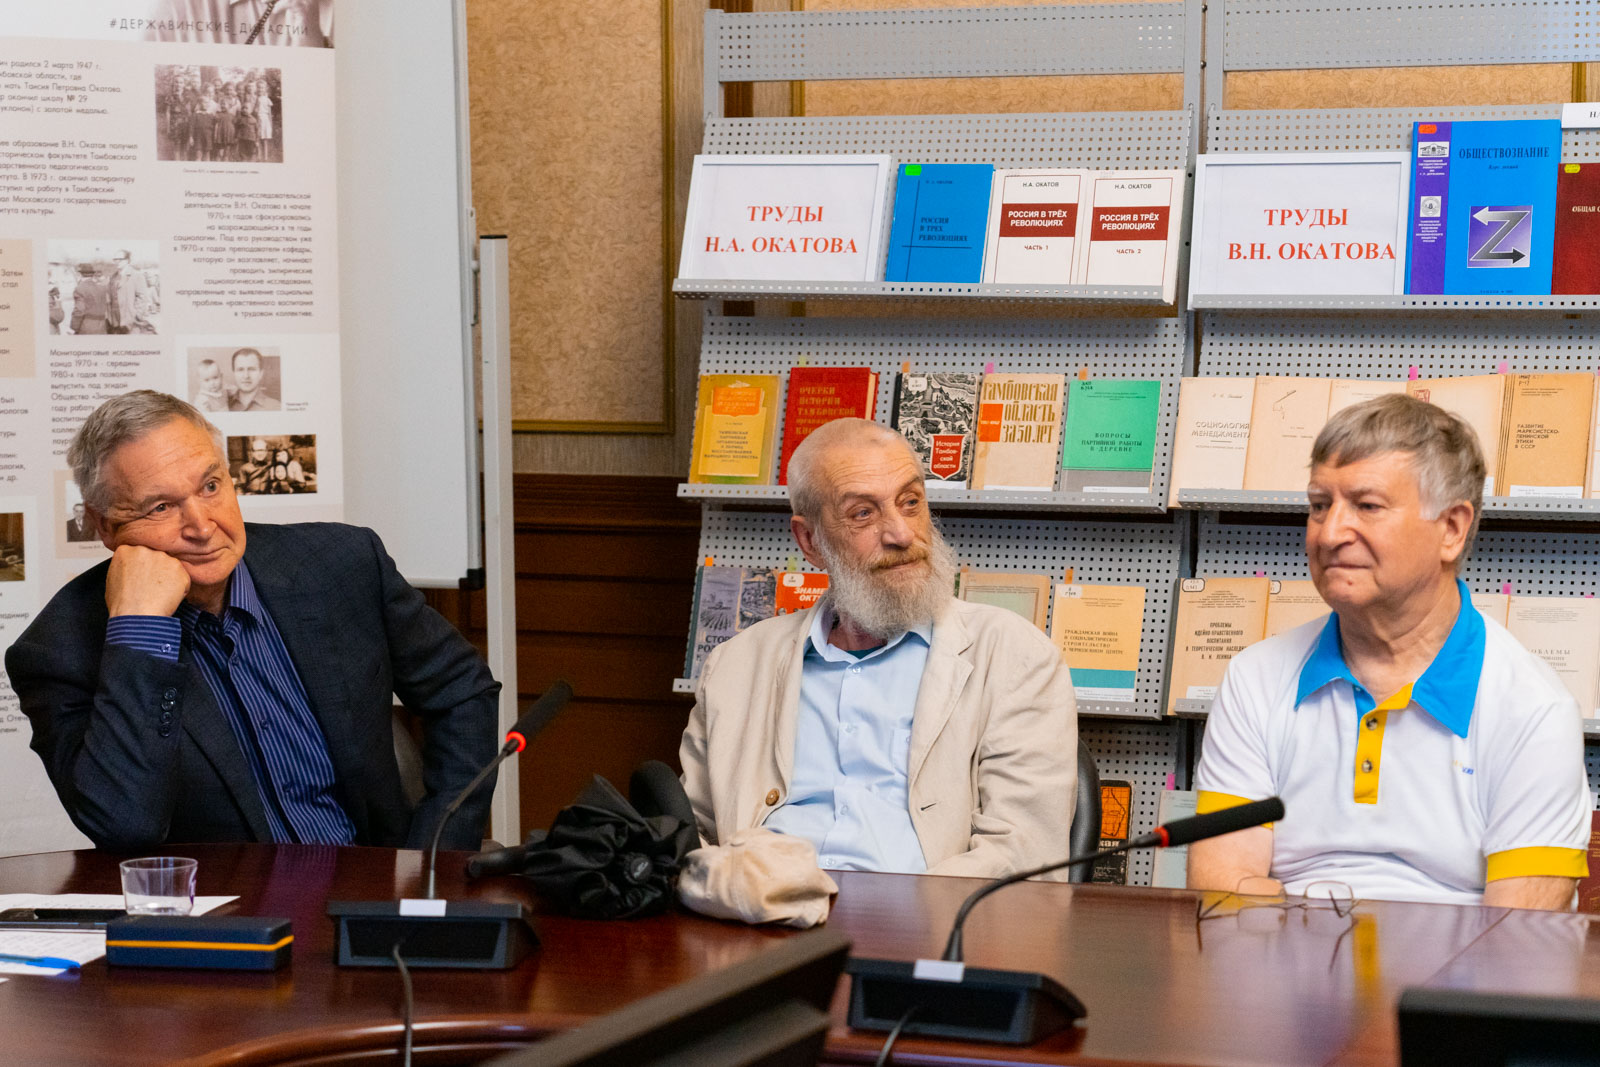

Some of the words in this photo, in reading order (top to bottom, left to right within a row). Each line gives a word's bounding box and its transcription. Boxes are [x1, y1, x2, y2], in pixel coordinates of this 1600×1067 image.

[44, 60, 49, 68] 2
[52, 82, 86, 93] Петровна
[12, 140, 59, 149] образование
[48, 152, 87, 160] факультете
[90, 152, 137, 160] Тамбовского
[1459, 147, 1550, 160] ОБЩЕСТВОЗНАНИЕ
[91, 176, 135, 184] аспирантуру
[37, 184, 62, 194] работу
[748, 206, 824, 224] ТРУДЫ
[1048, 209, 1067, 218] ТРЁХ
[1140, 213, 1159, 221] ТРЁХ
[1010, 219, 1064, 227] РЕВОЛЮЦИЯХ
[1263, 208, 1349, 230] ТРУДЫ
[1102, 222, 1155, 230] РЕВОЛЮЦИЯХ
[705, 236, 745, 253] Н.А.
[752, 235, 858, 254] ОКАТОВА
[1228, 243, 1272, 260] В.Н.
[1278, 242, 1396, 260] ОКАТОВА
[800, 386, 835, 394] ОЧЕРКИ
[798, 407, 856, 416] ТАМБОВСКОЙ
[1195, 421, 1250, 430] СОЦИОЛОГИЯ
[1017, 424, 1032, 443] 50
